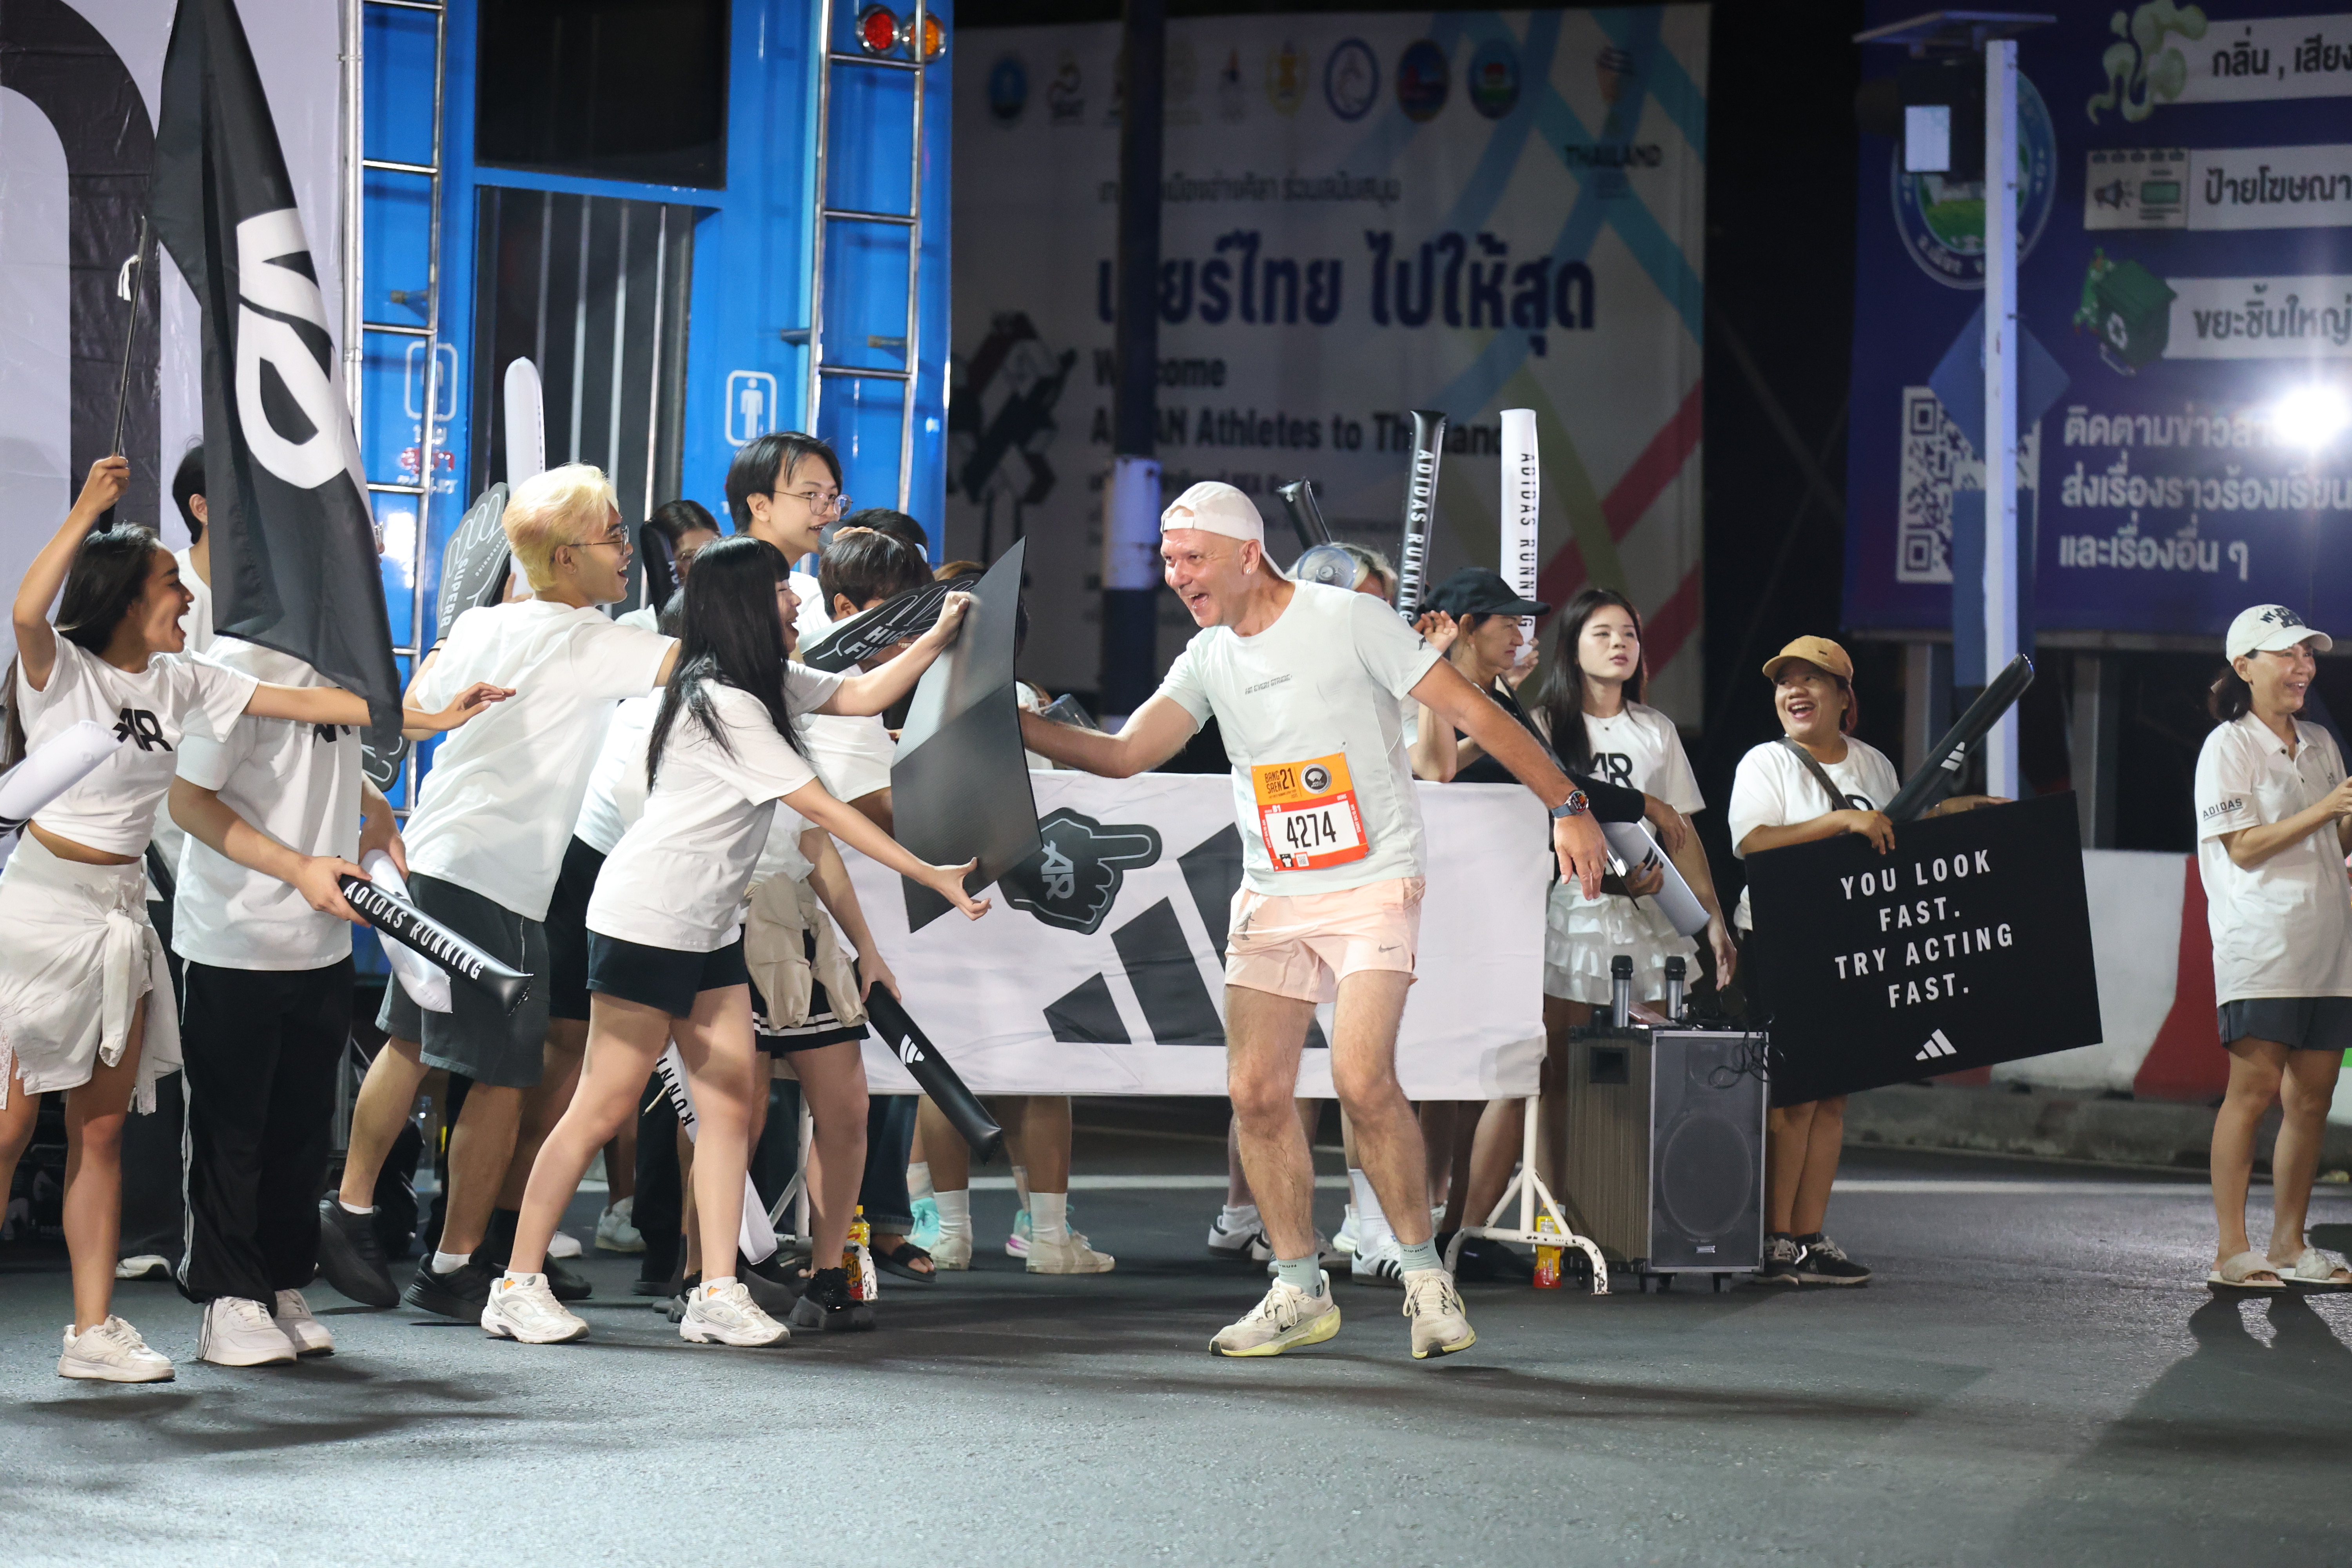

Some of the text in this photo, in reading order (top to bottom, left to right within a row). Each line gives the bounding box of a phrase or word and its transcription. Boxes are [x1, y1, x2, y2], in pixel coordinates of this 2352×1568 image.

[2212, 26, 2270, 76] กลิ่น
[1098, 229, 1595, 358] เยร์ไทย ไปให้สุด
[1196, 408, 1322, 449] Athletes
[1332, 413, 1363, 452] to
[1399, 449, 1436, 624] ADIDAS RUNNING
[1518, 453, 1535, 627] ADIDAS RUNNIG
[2058, 510, 2220, 573] และเรื่องอื่น
[439, 557, 469, 628] SUPERB
[843, 641, 884, 660] FIV
[863, 625, 906, 645] HIG
[1264, 770, 1280, 783] BANG
[1266, 780, 1283, 795] SAEN
[1279, 767, 1296, 790] 21
[1286, 810, 1337, 849] 4274
[2202, 797, 2243, 819] ADIDAS
[1840, 849, 1991, 900] YOU LOOK
[343, 880, 485, 981] ADIDAS RUNNING
[1879, 897, 1961, 932] FAST.
[1835, 923, 2014, 980] TRY ACTING
[1888, 973, 1970, 1009] FAST.
[656, 1057, 696, 1127] RUNNI
